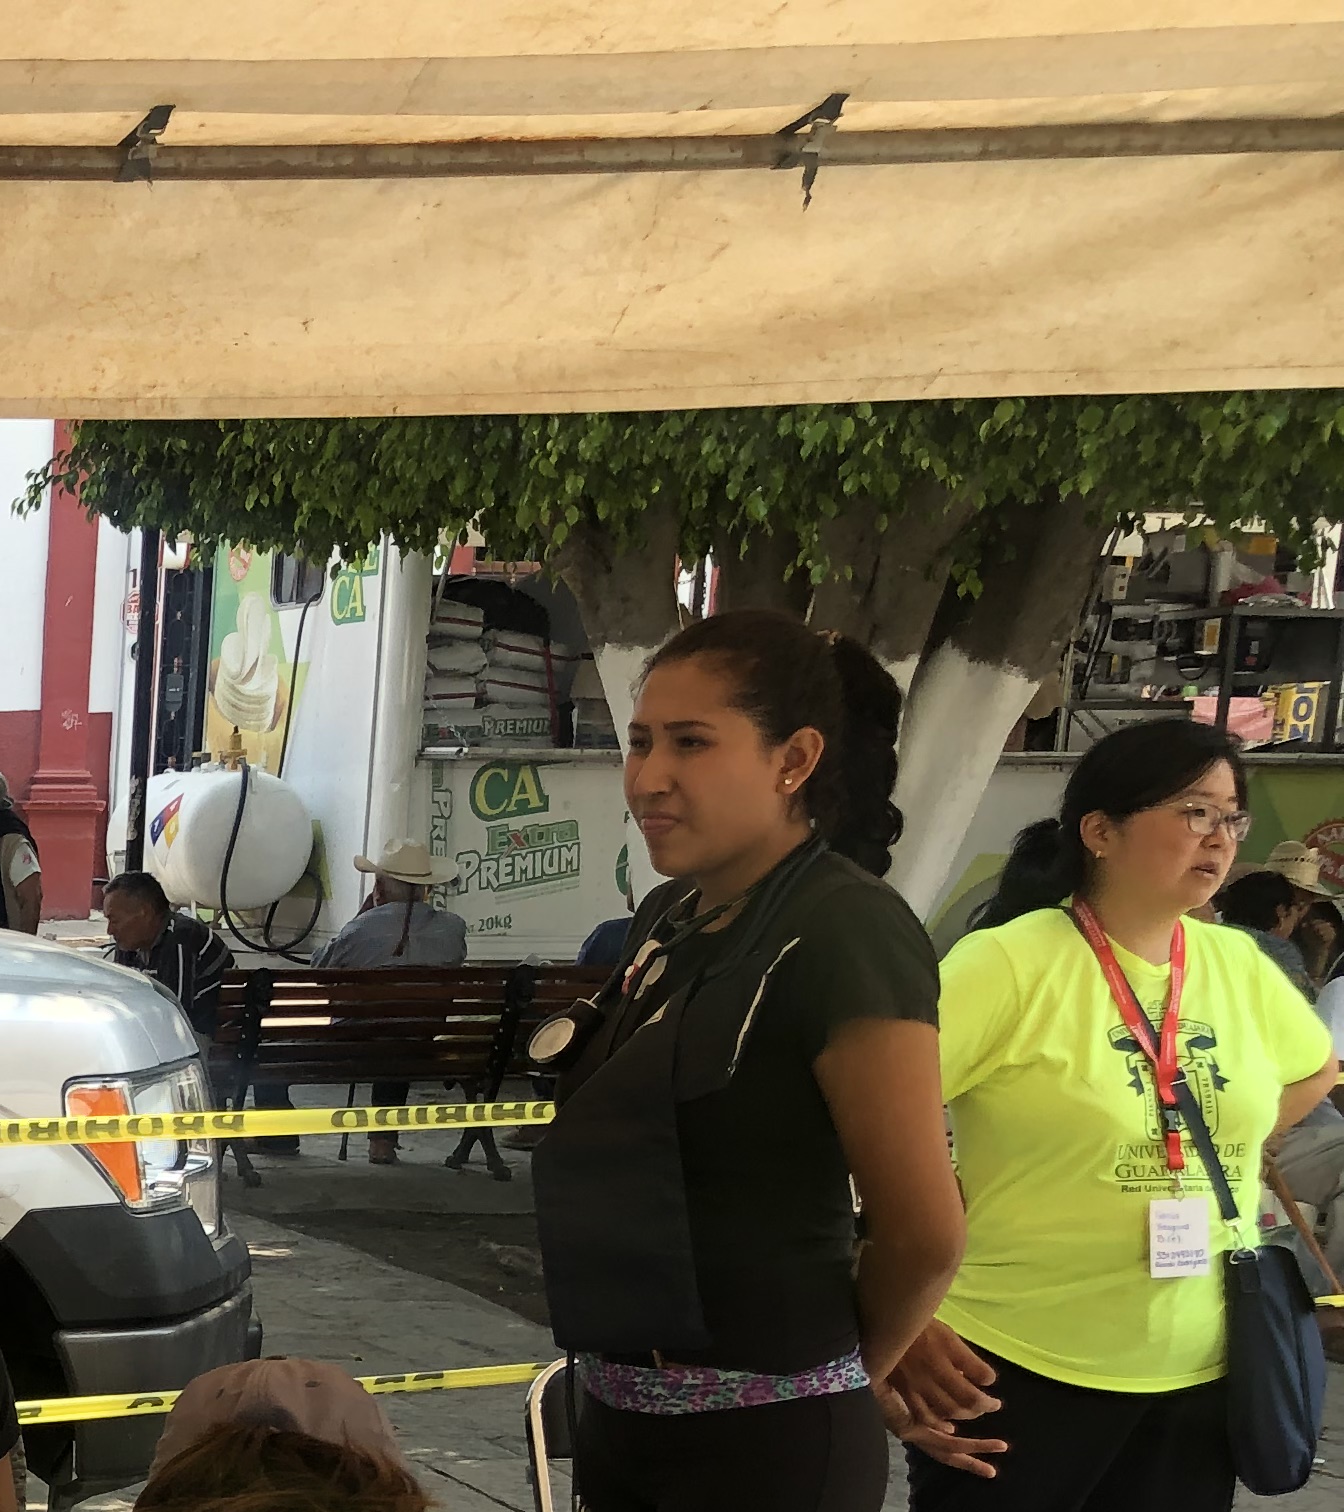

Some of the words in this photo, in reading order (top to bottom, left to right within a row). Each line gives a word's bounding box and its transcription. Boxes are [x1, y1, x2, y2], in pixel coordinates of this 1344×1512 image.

[333, 574, 364, 620] CA
[474, 764, 544, 816] CA
[486, 819, 580, 857] Extra
[456, 843, 581, 894] PREMIUM
[478, 914, 513, 932] 20kg
[1223, 1142, 1246, 1158] DE
[1121, 1184, 1141, 1193] Red
